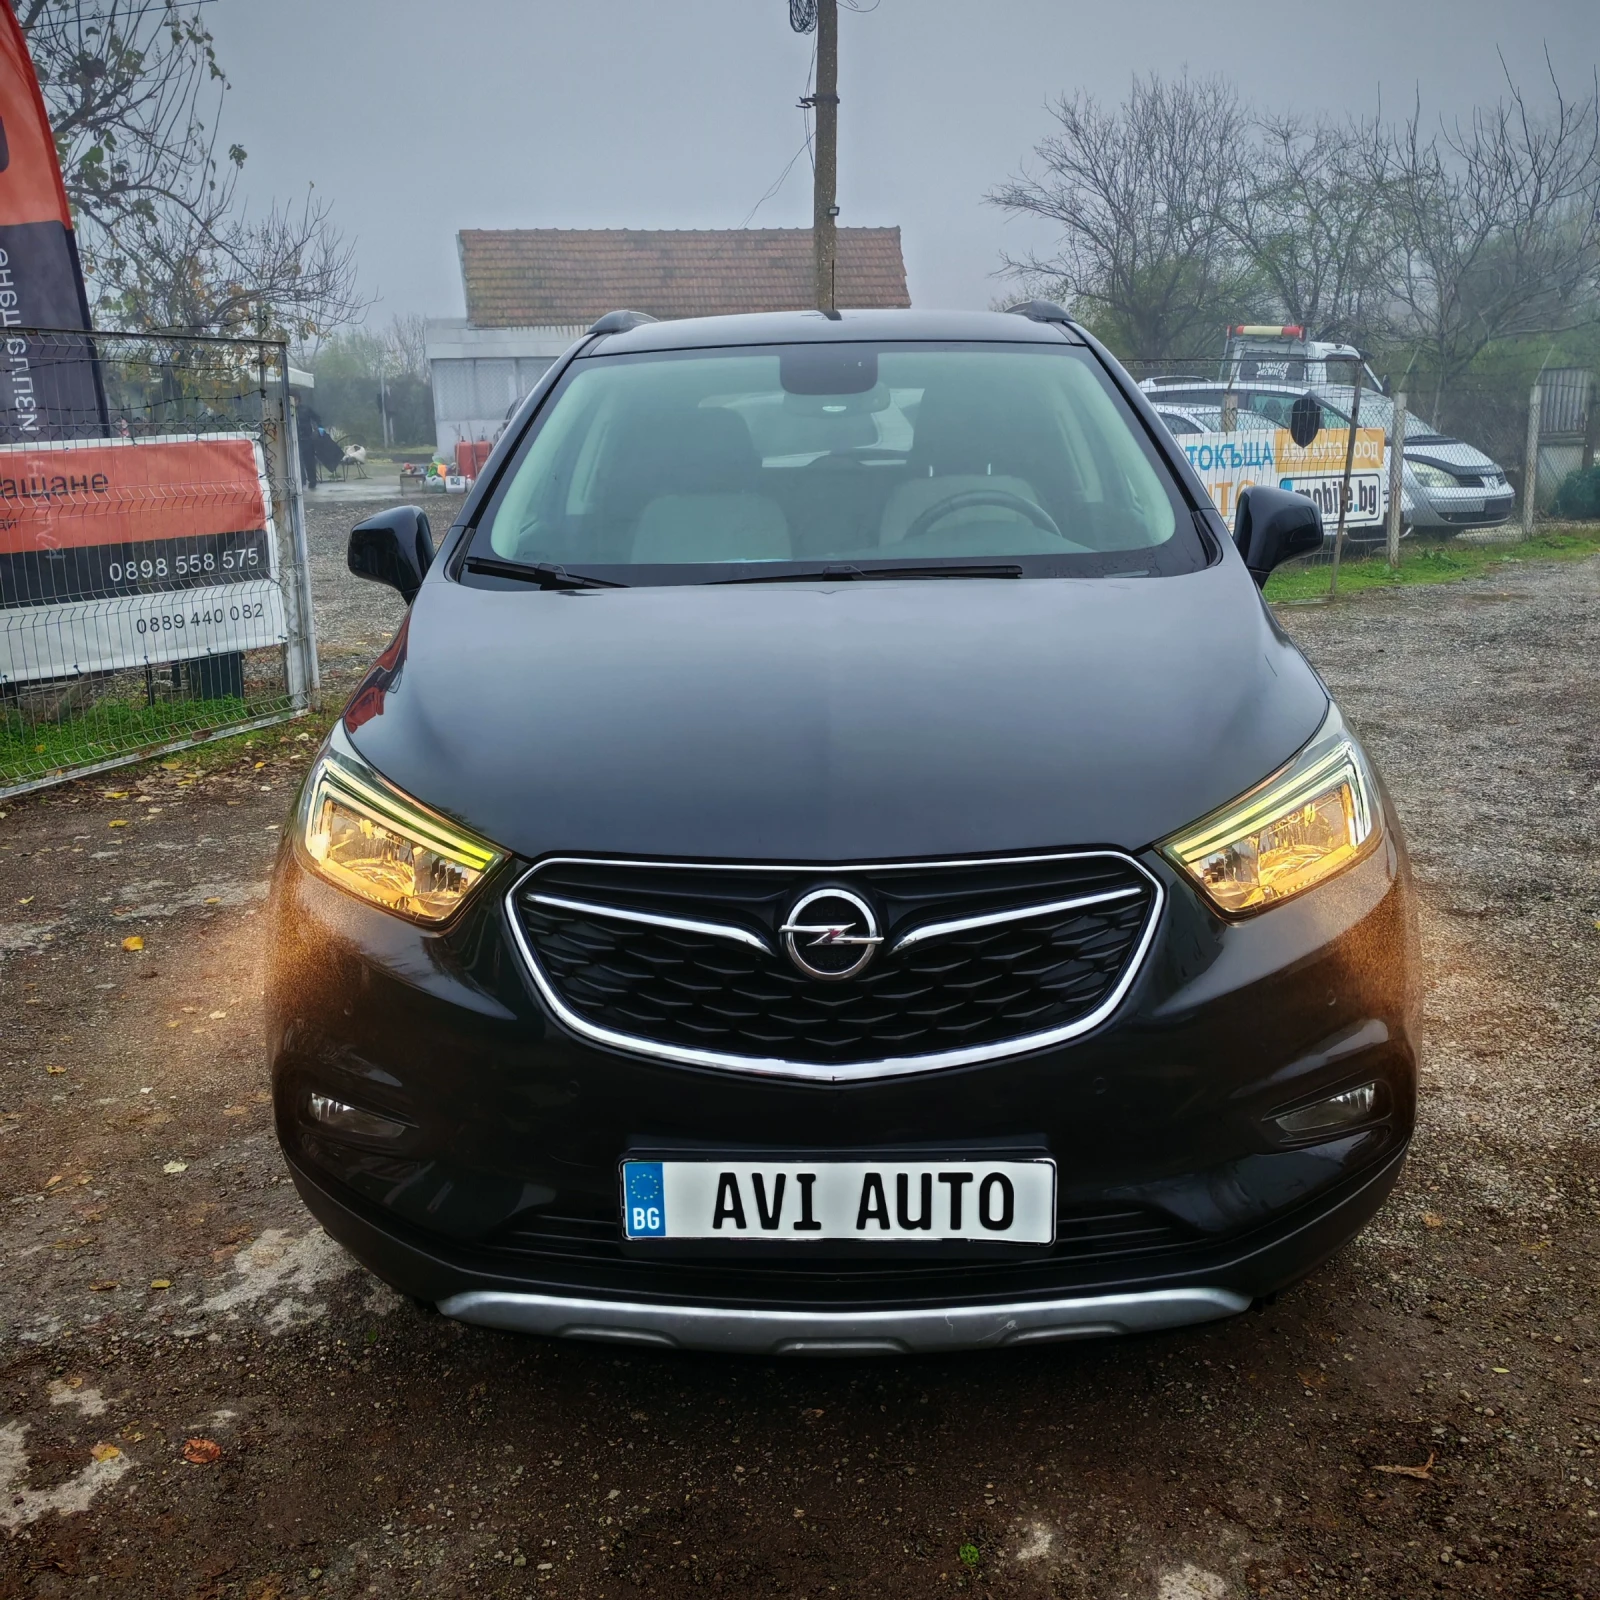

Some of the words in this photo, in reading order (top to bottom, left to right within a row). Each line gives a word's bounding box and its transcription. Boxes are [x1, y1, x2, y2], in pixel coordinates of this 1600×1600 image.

[1346, 440, 1379, 461] ООД
[109, 558, 168, 582] 0898
[175, 553, 215, 574] 558
[222, 547, 259, 569] 575
[136, 613, 185, 634] 0889
[190, 608, 224, 627] 440
[229, 603, 264, 621] 082
[712, 1172, 822, 1230] AVI
[856, 1172, 1015, 1231] AUTO
[632, 1207, 660, 1230] BG
